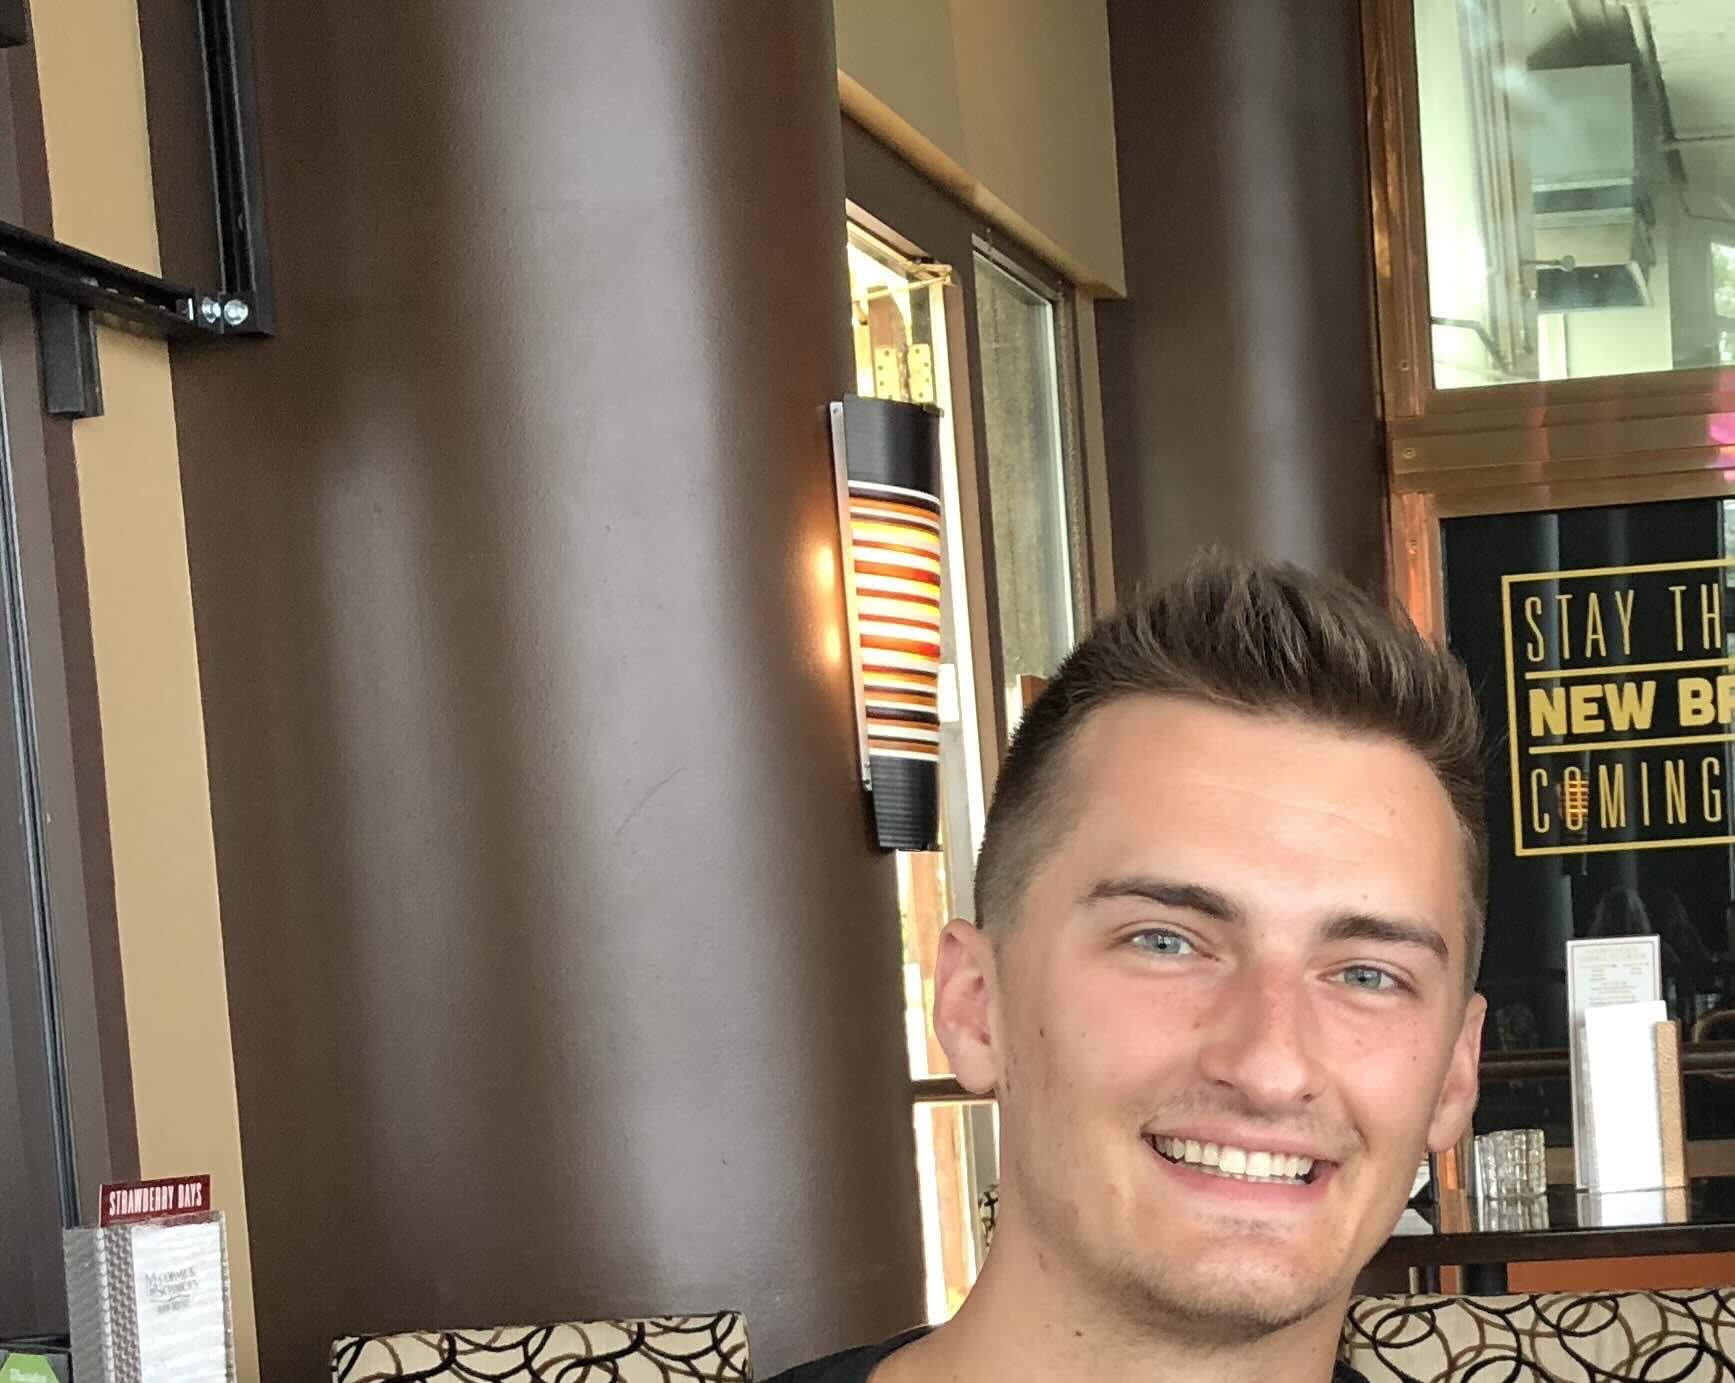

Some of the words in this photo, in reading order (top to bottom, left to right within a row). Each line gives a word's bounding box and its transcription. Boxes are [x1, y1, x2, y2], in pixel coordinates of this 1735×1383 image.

[1524, 589, 1634, 662] STAY
[1529, 680, 1656, 737] NEW
[1531, 757, 1722, 833] COMING
[109, 1185, 174, 1216] STRAWBERRY
[178, 1182, 202, 1208] DAYS
